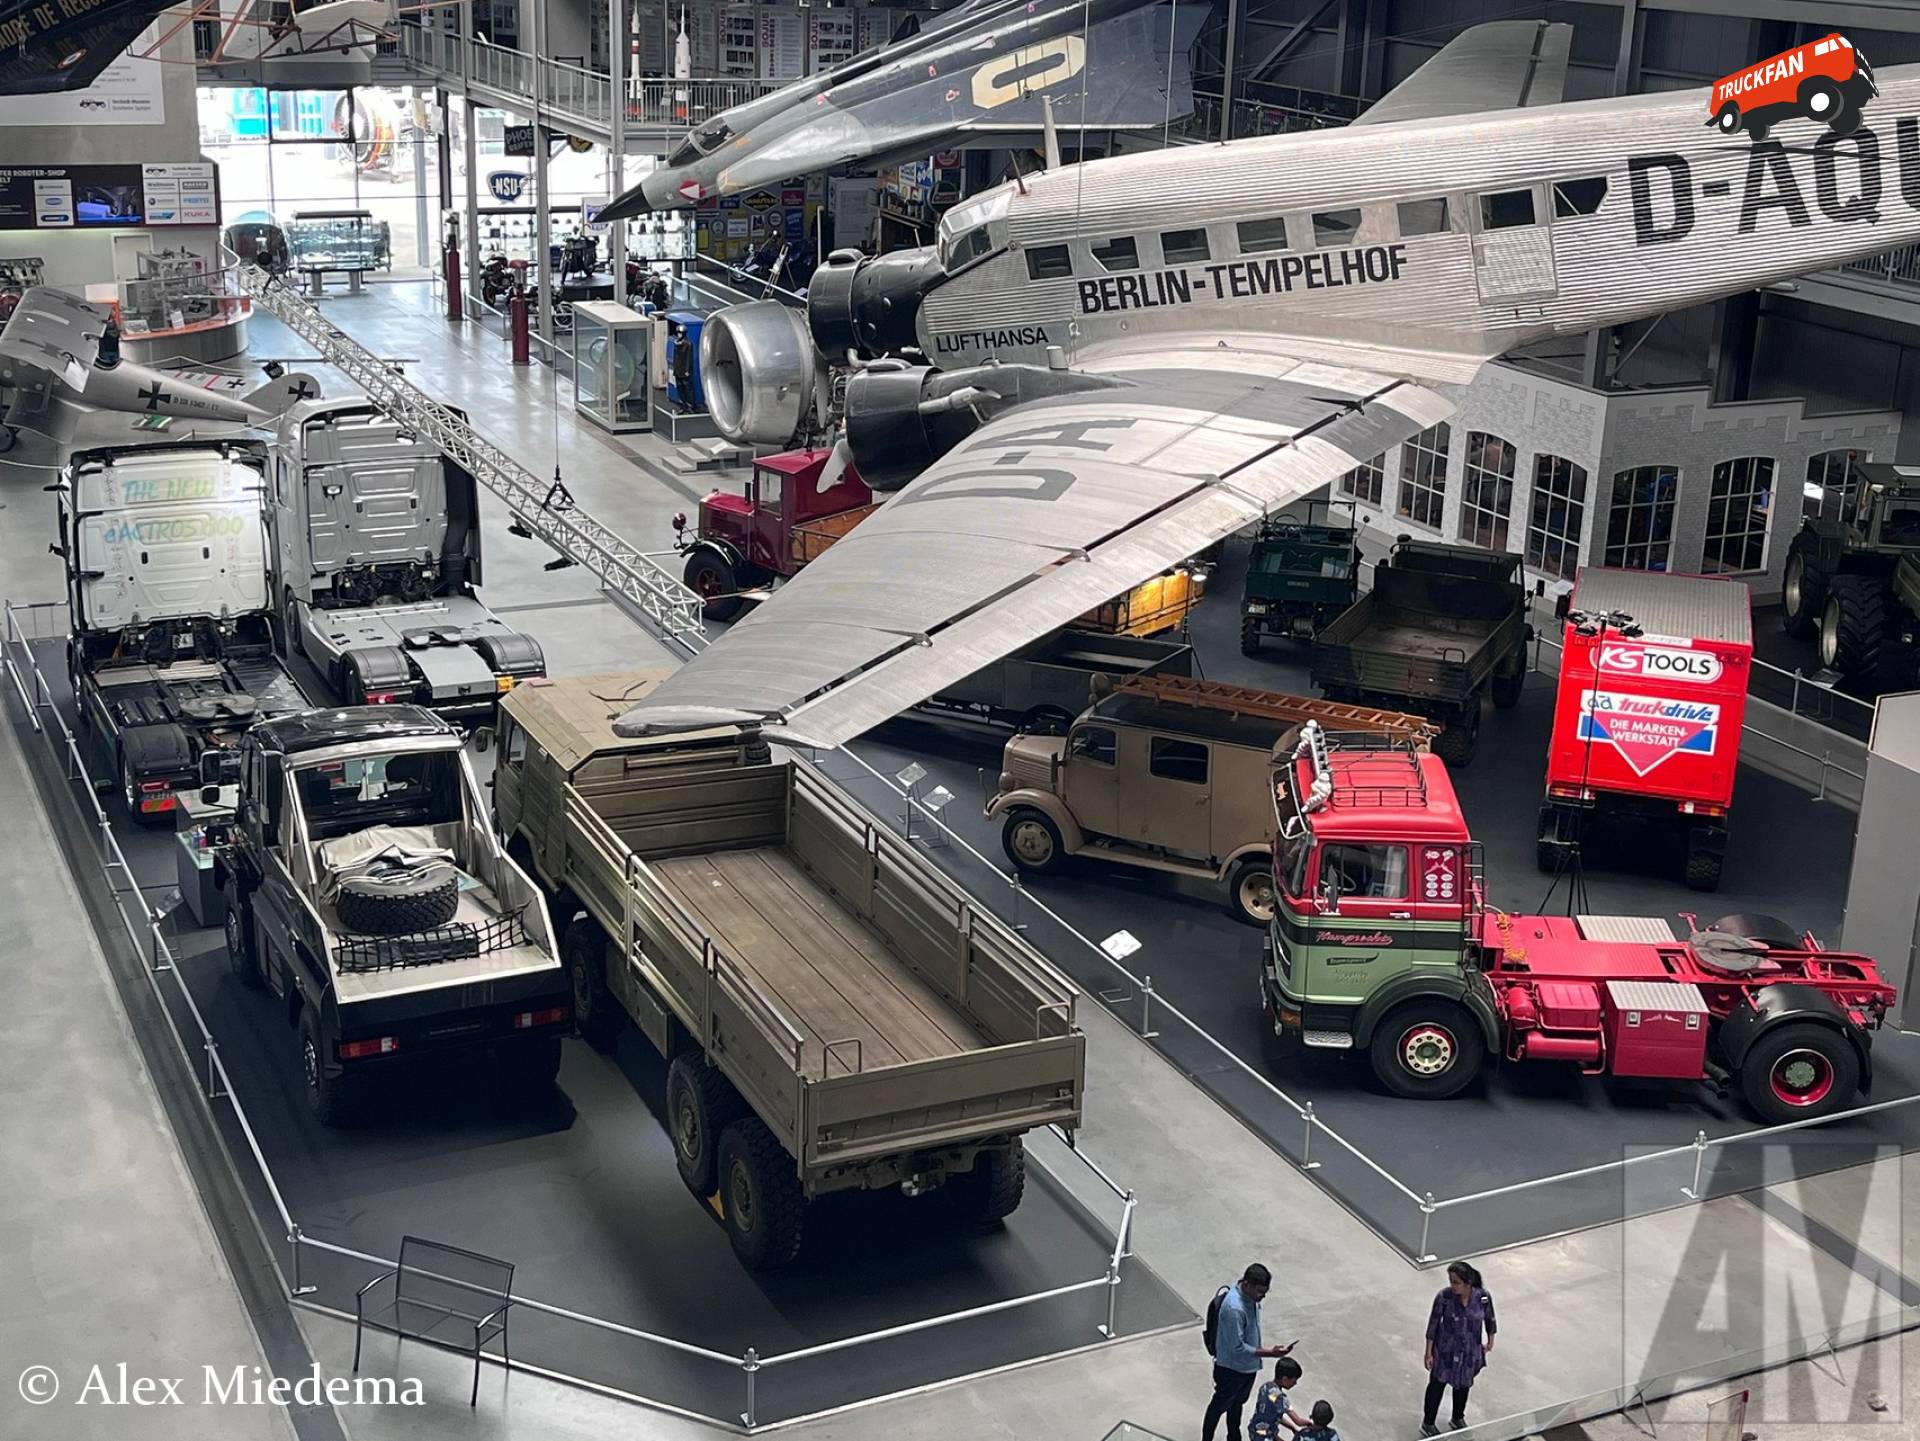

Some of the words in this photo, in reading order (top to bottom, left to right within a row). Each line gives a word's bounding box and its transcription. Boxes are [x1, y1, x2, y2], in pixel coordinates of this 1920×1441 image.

[32, 3, 59, 30] DE
[505, 128, 533, 145] PHOE
[495, 177, 518, 196] NSU
[1077, 244, 1408, 315] BERLIN-TEMPELHOF
[935, 326, 1049, 353] LUFTHANSA
[122, 480, 160, 502] THE
[166, 476, 216, 498] NEW
[1600, 647, 1644, 670] KS
[1644, 653, 1711, 676] TOOLS
[1618, 698, 1714, 722] truckdrive
[1609, 718, 1629, 731] DIE
[1631, 720, 1688, 736] MARKEN-
[1613, 731, 1681, 748] WERKSTATT
